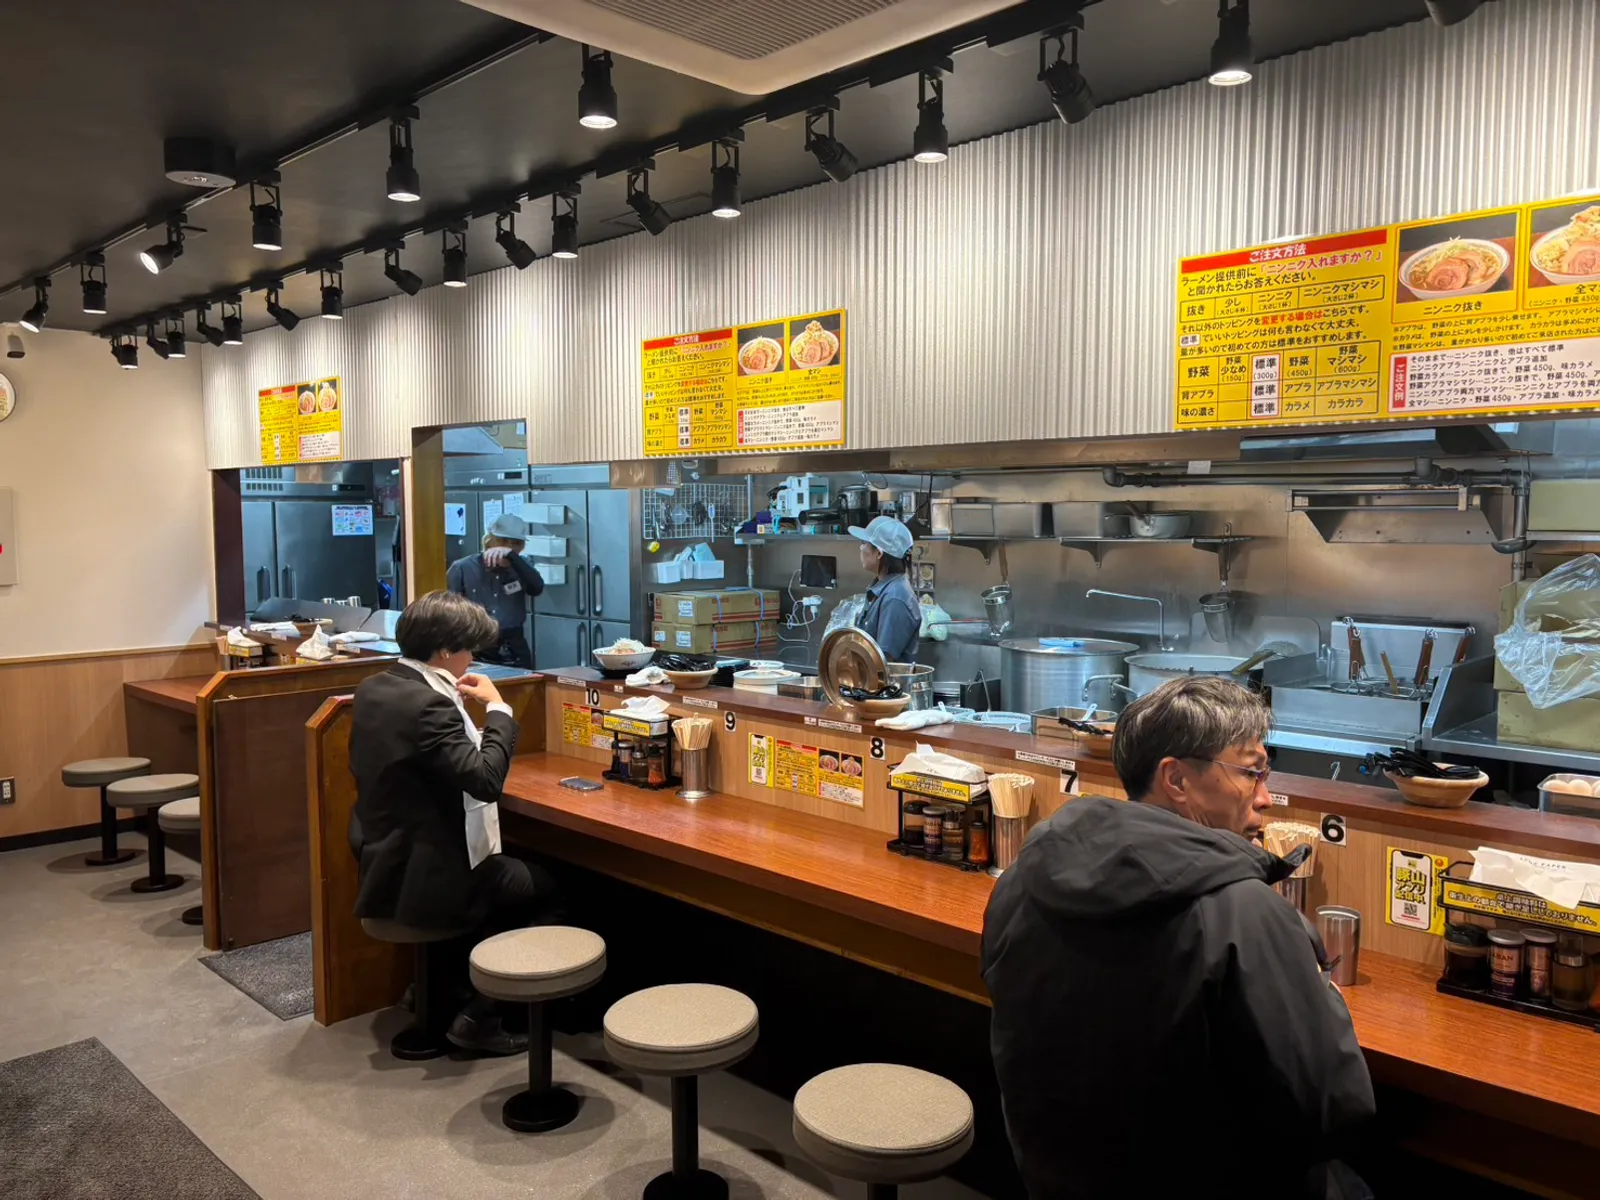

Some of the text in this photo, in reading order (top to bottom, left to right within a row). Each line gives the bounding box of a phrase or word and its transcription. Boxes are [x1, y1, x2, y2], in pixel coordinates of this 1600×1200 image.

[1249, 243, 1307, 263] ご注文方法
[1303, 280, 1380, 298] ニンニクマシマシ
[1225, 297, 1242, 308] 少し
[1257, 290, 1293, 303] ニンニク
[1186, 304, 1206, 317] 抜き
[1423, 301, 1483, 315] ニンニク抜き
[1180, 335, 1198, 345] 標準
[1338, 345, 1359, 355] 野菜
[1225, 355, 1242, 365] 野菜
[1255, 357, 1277, 369] 標準
[1288, 355, 1310, 367] 野菜
[1327, 354, 1367, 366] マシマシ
[1187, 364, 1210, 378] 野菜
[1220, 364, 1247, 376] 少なめ
[1254, 384, 1276, 396] 標準
[1284, 381, 1312, 393] アブラ
[1317, 378, 1377, 391] アブラマシマシ
[1253, 402, 1275, 414] 標準
[1285, 400, 1310, 411] カラメ
[1327, 397, 1364, 409] カラカラ
[1181, 406, 1215, 417] 味の濃さ
[586, 688, 600, 706] 10
[725, 712, 736, 731] 9
[870, 737, 884, 758] 8
[1061, 769, 1078, 793] 7
[1321, 814, 1345, 843] 6
